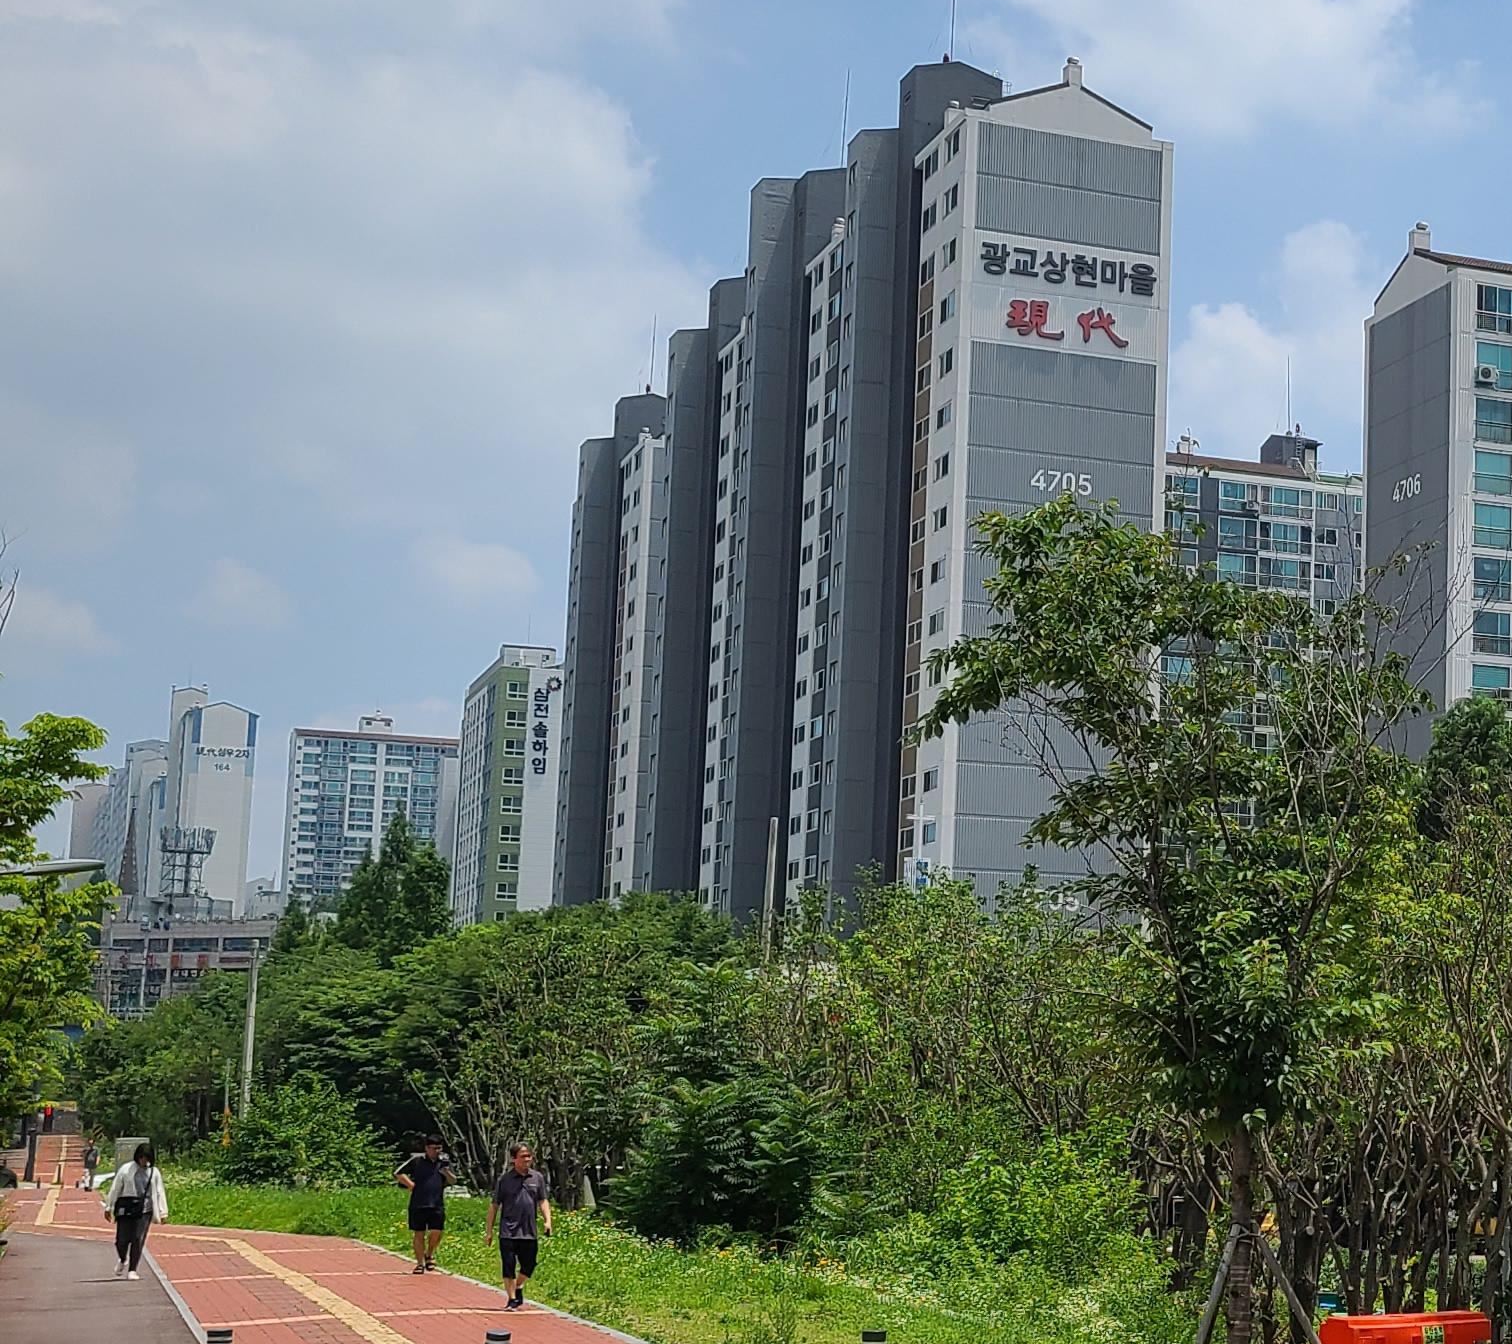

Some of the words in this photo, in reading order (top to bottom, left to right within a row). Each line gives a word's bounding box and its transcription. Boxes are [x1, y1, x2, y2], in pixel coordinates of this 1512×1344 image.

[981, 241, 1157, 296] 광교상현마을
[1030, 469, 1092, 496] 4705
[1392, 473, 1421, 502] 4706
